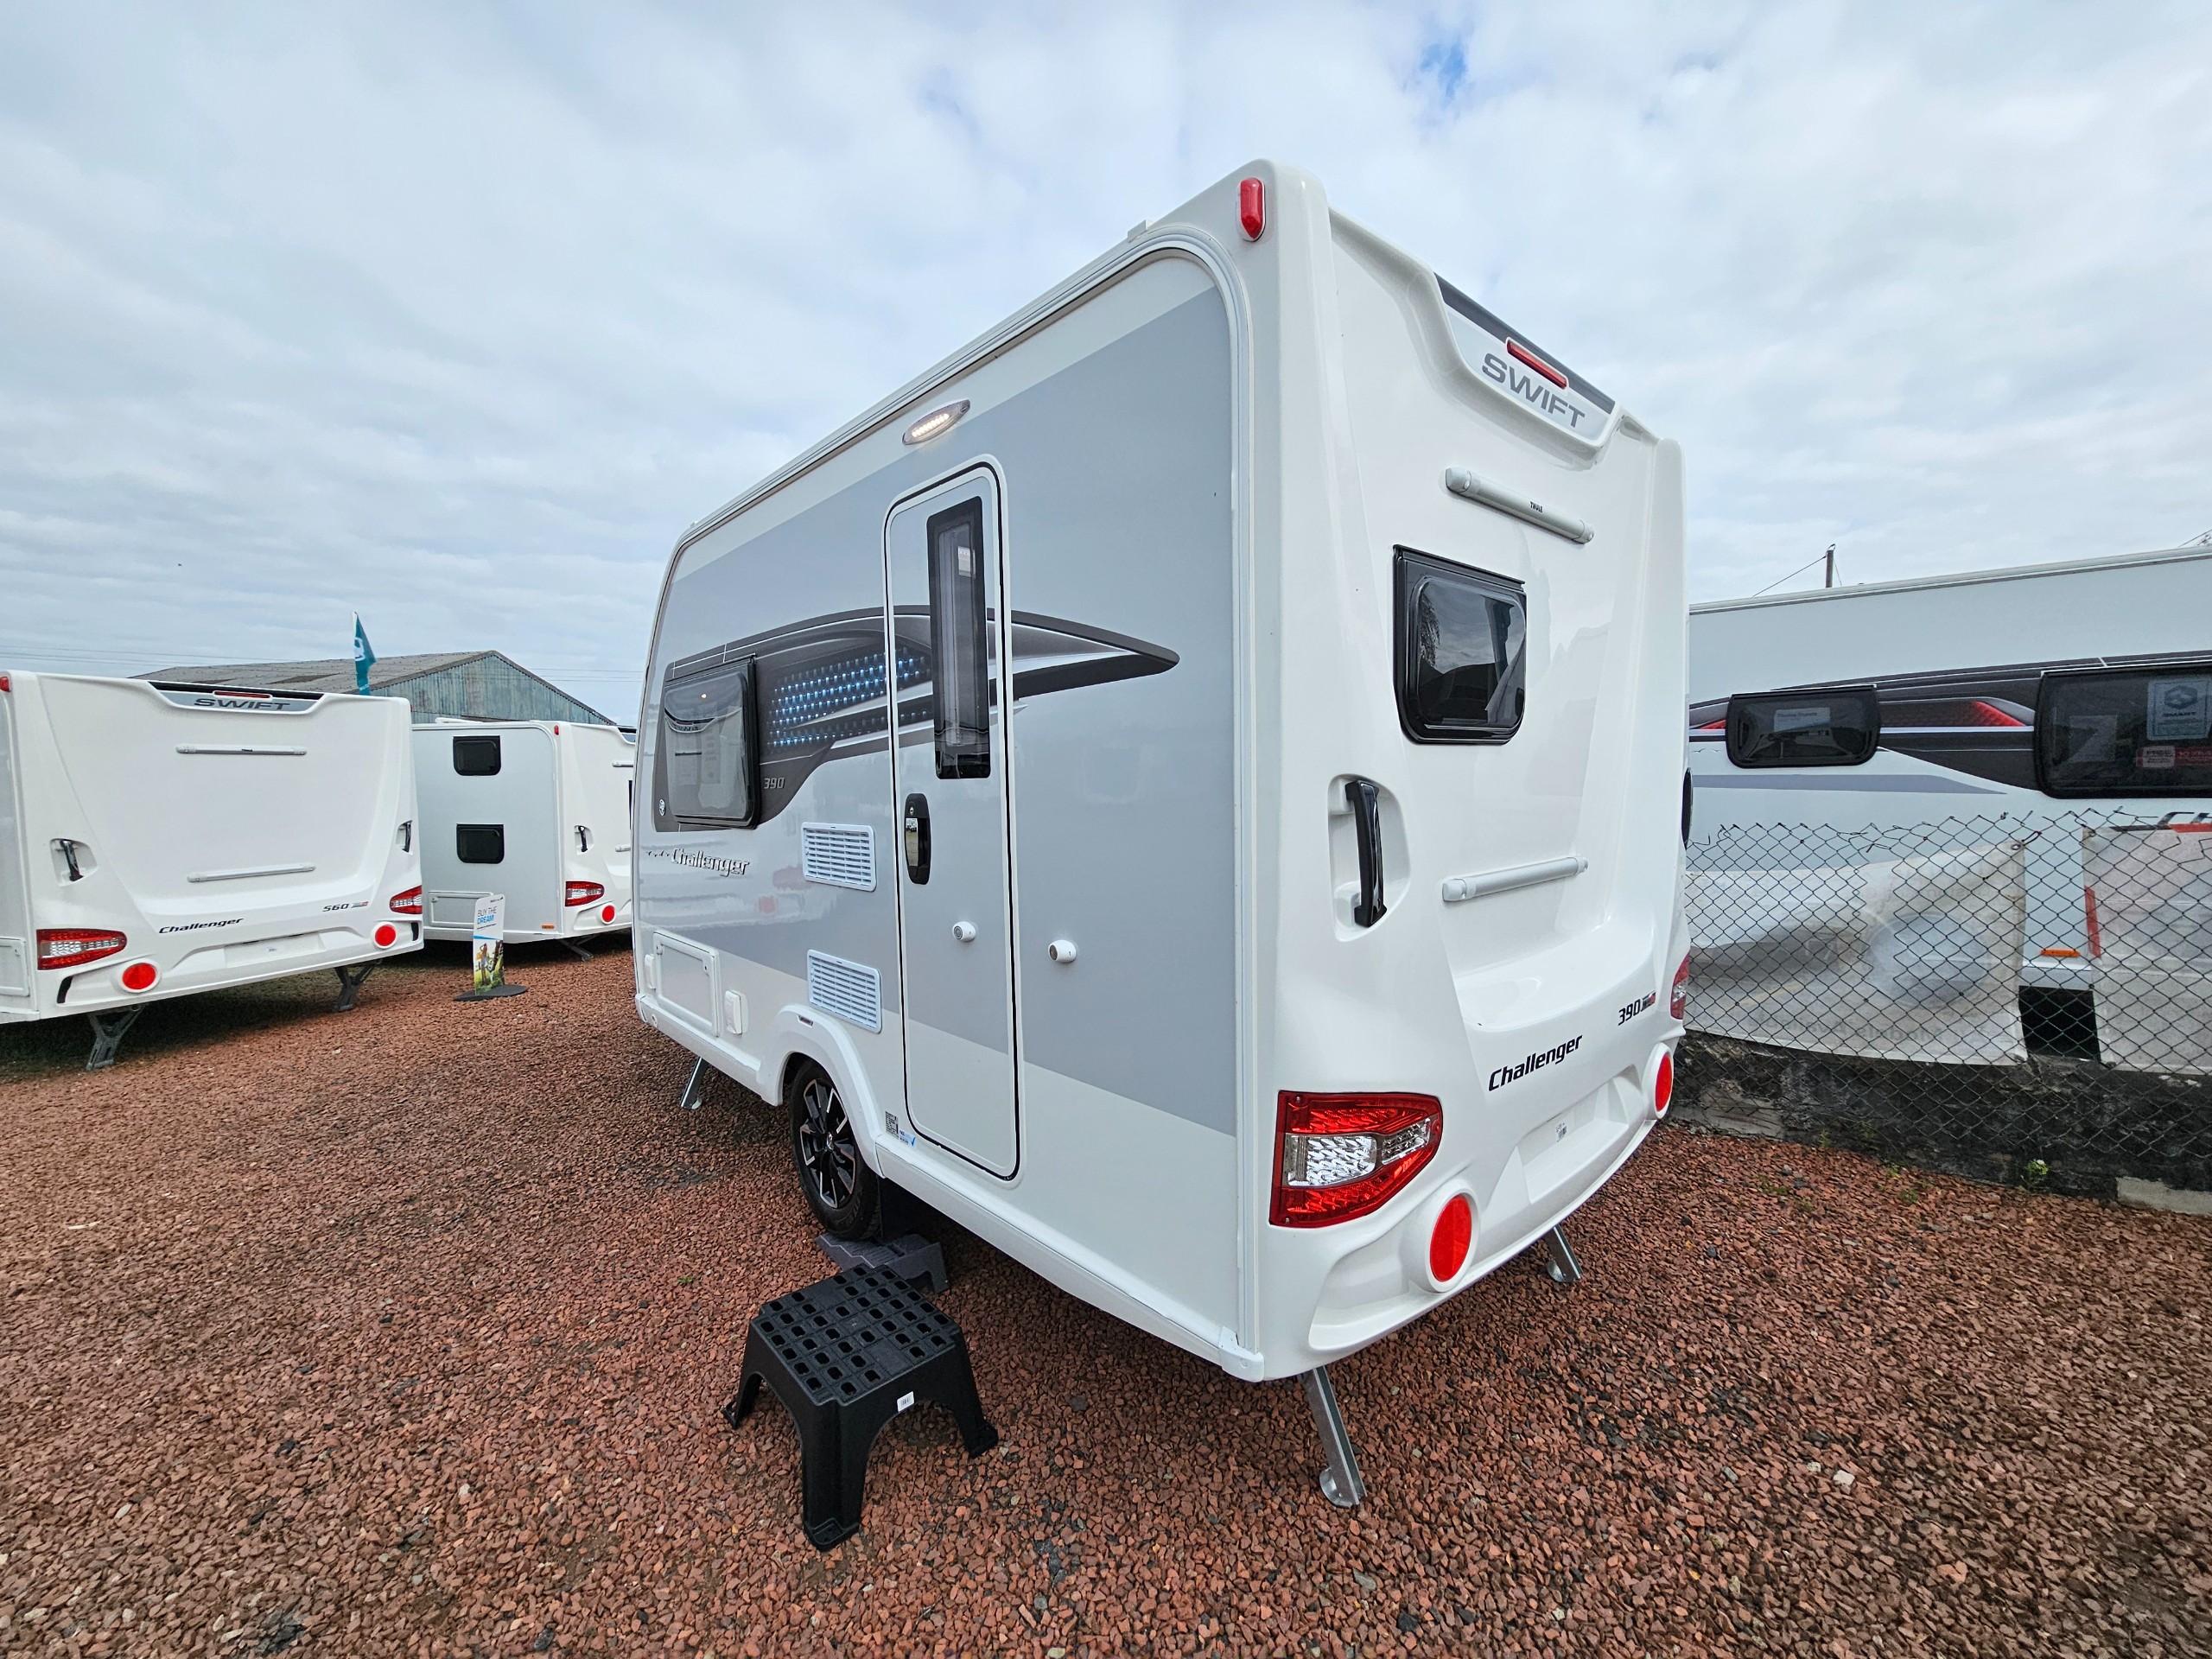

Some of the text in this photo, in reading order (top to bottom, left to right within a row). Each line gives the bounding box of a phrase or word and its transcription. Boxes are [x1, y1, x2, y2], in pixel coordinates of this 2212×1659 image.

[1482, 353, 1586, 429] SWIFT
[194, 698, 290, 710] SWIFT
[764, 777, 785, 790] 390
[672, 848, 751, 877] Challenger
[477, 906, 498, 918] BUY THE
[477, 914, 494, 925] DREAM
[158, 918, 245, 934] Challenger
[1618, 998, 1641, 1027] 390
[1488, 1034, 1583, 1092] Challenger
